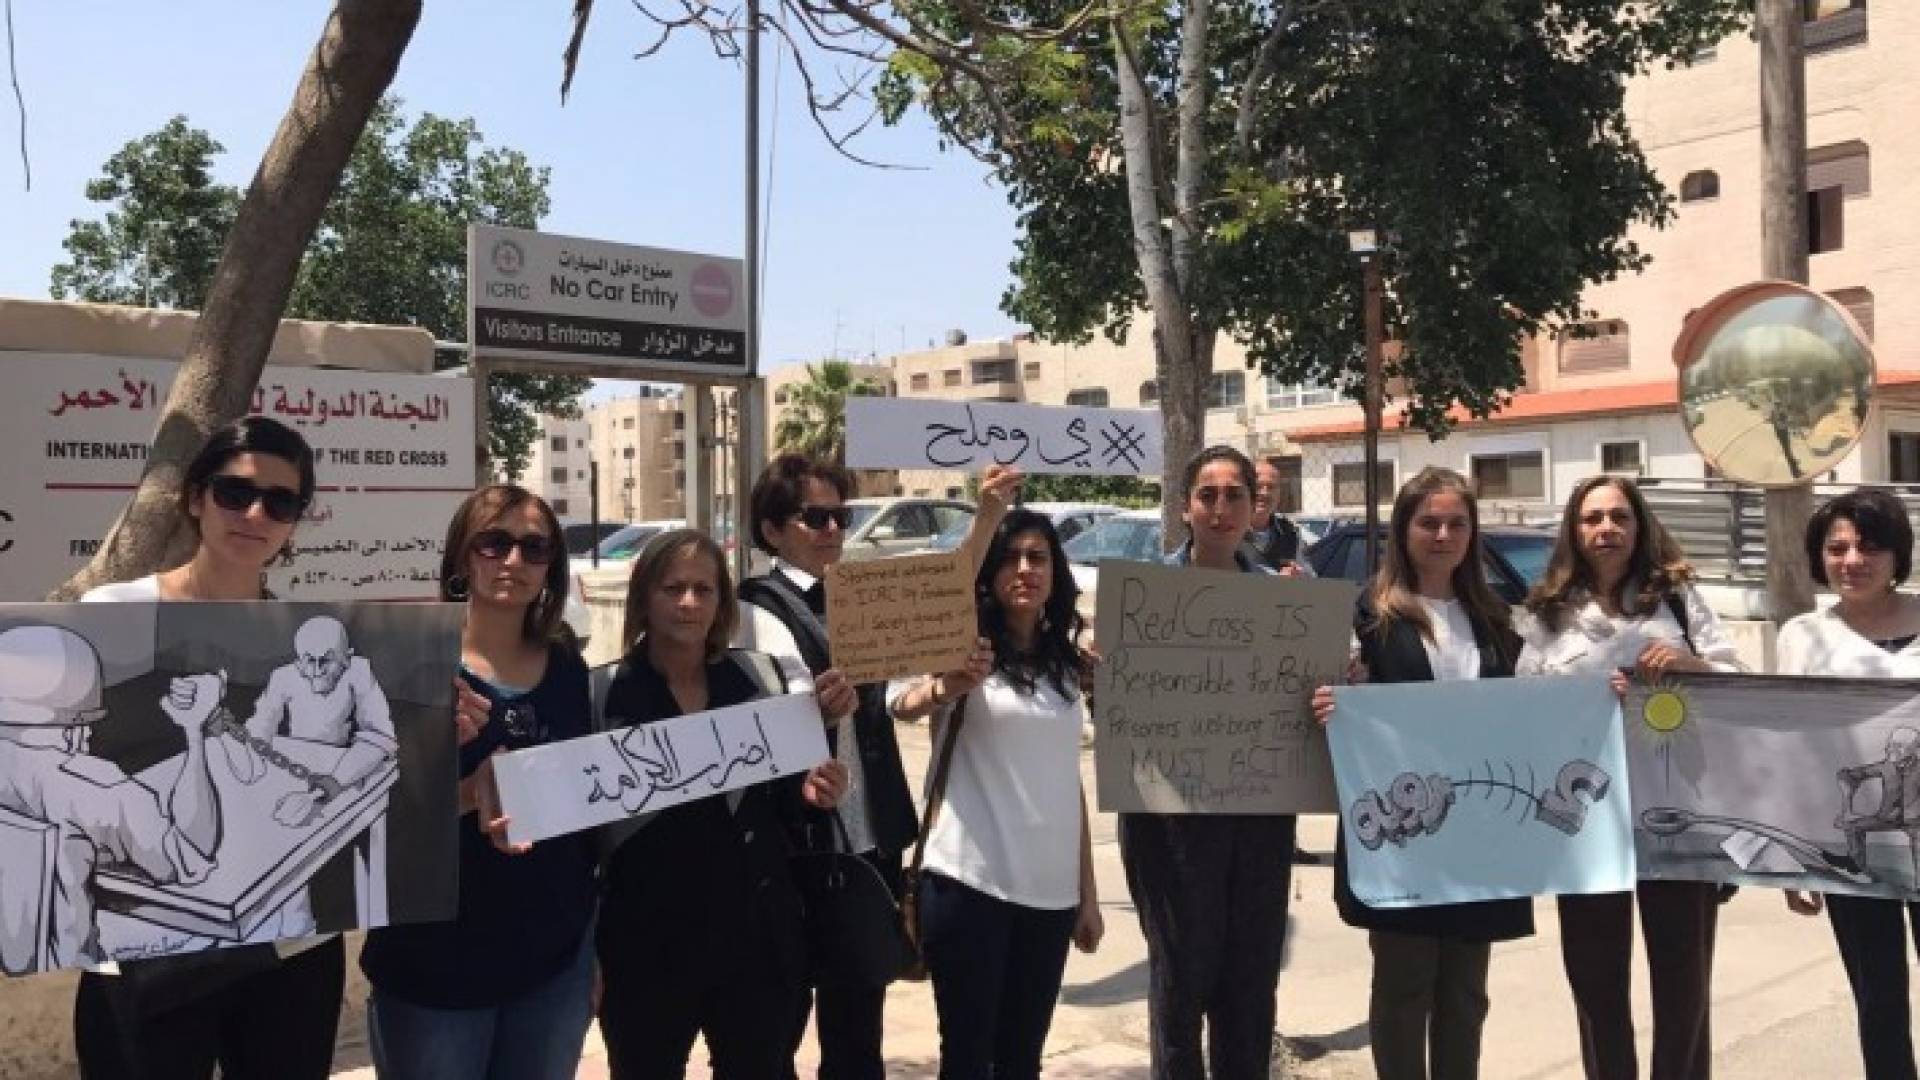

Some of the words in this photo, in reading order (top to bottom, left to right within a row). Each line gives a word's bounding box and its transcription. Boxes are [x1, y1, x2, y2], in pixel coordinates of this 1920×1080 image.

[485, 280, 531, 300] ICRC
[550, 275, 581, 298] No
[587, 279, 625, 302] Car
[631, 283, 679, 312] Entry
[483, 316, 544, 342] Visitors
[548, 323, 622, 347] Entrance
[47, 367, 158, 416] الأحمر
[274, 384, 366, 424] الدولية
[369, 390, 449, 429] اللجنة
[46, 441, 149, 460] INTERNATI
[330, 450, 360, 464] THE
[364, 450, 395, 465] RED
[399, 450, 448, 466] CROSS
[69, 539, 105, 557] FRO
[855, 585, 898, 606] ICRC
[1271, 603, 1314, 639] IS
[1106, 650, 1235, 698] Responsible
[1249, 655, 1274, 693] for
